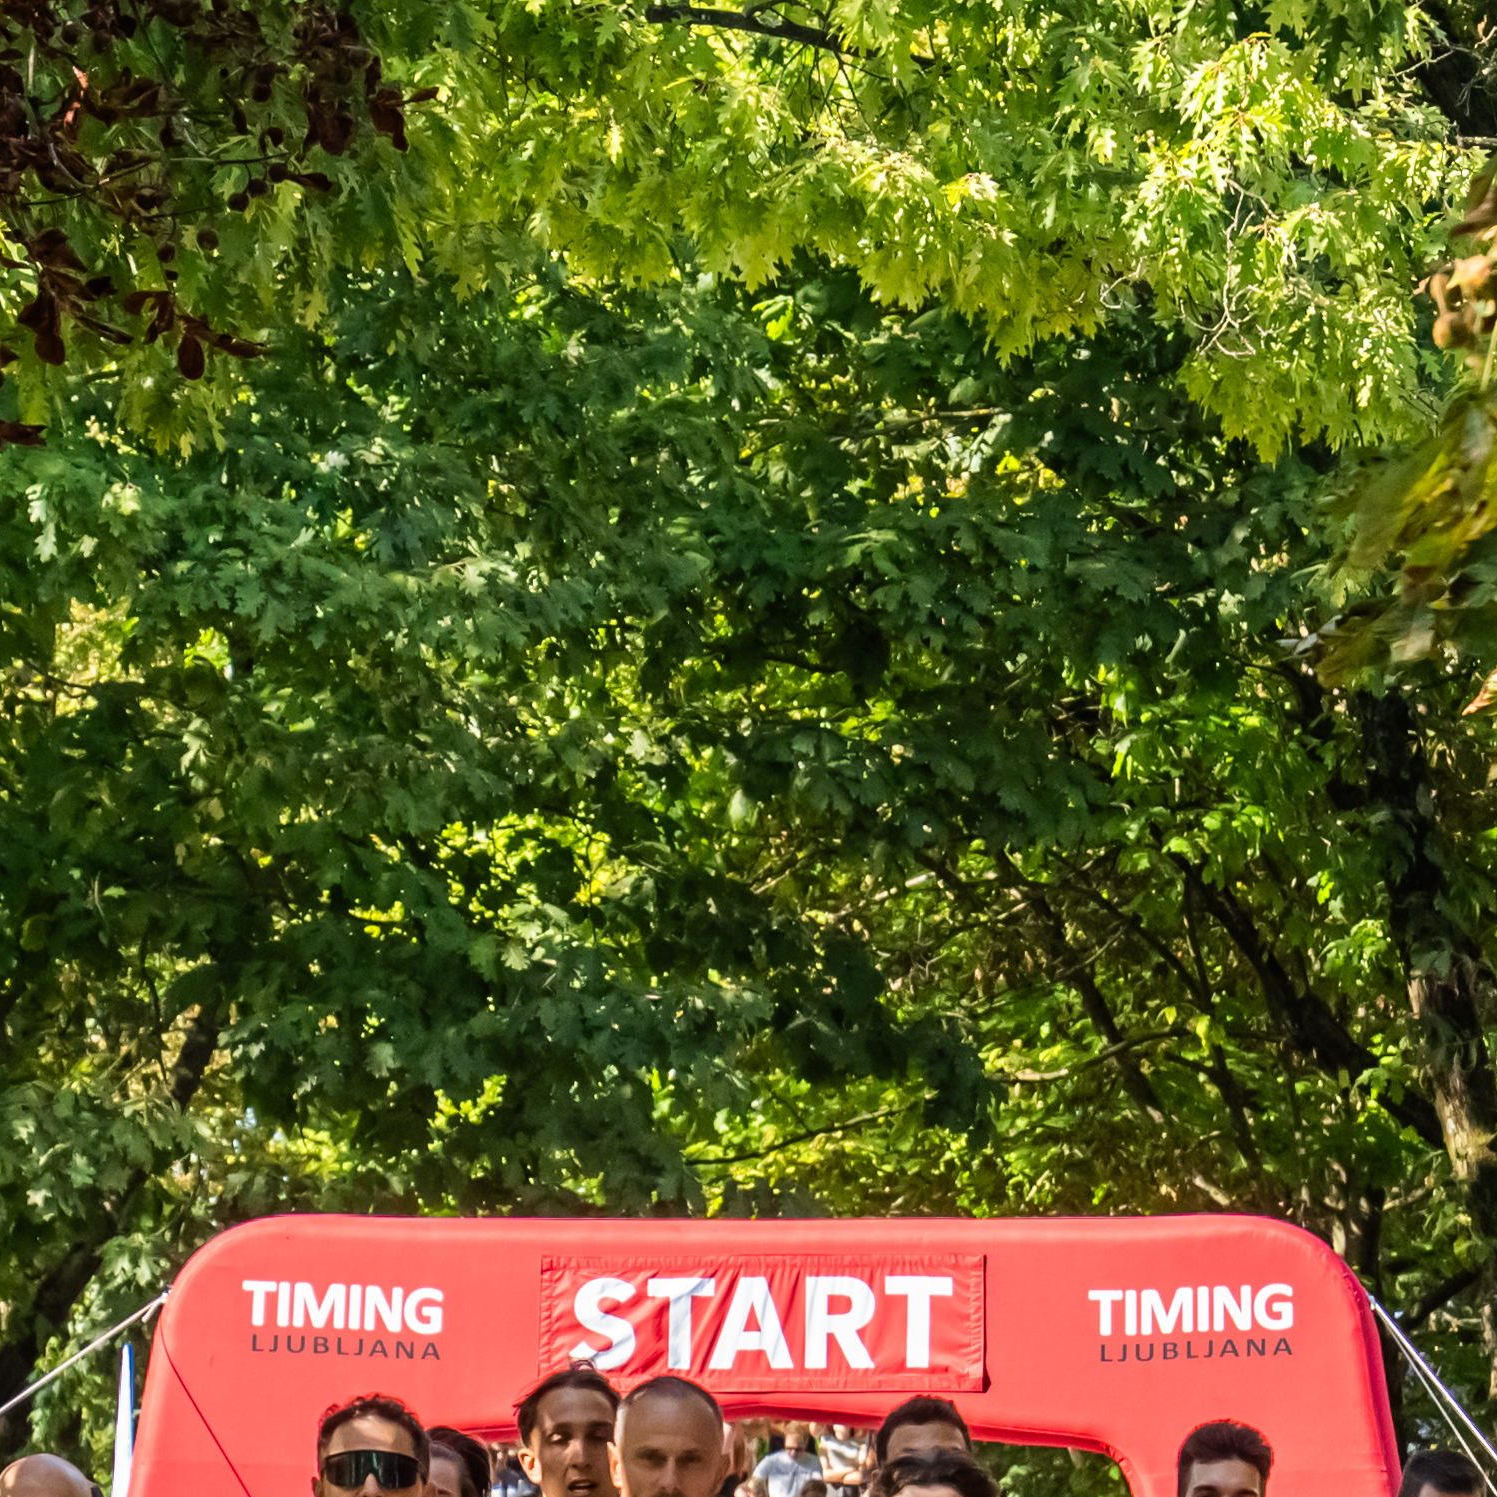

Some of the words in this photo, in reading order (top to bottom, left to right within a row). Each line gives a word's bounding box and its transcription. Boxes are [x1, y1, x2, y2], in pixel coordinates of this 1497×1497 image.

[242, 1279, 444, 1335] TIMING
[569, 1275, 954, 1370] START
[1088, 1283, 1294, 1337] TIMING
[251, 1334, 441, 1361] LJUBLJANA
[1100, 1337, 1293, 1363] LJUBLJANA
